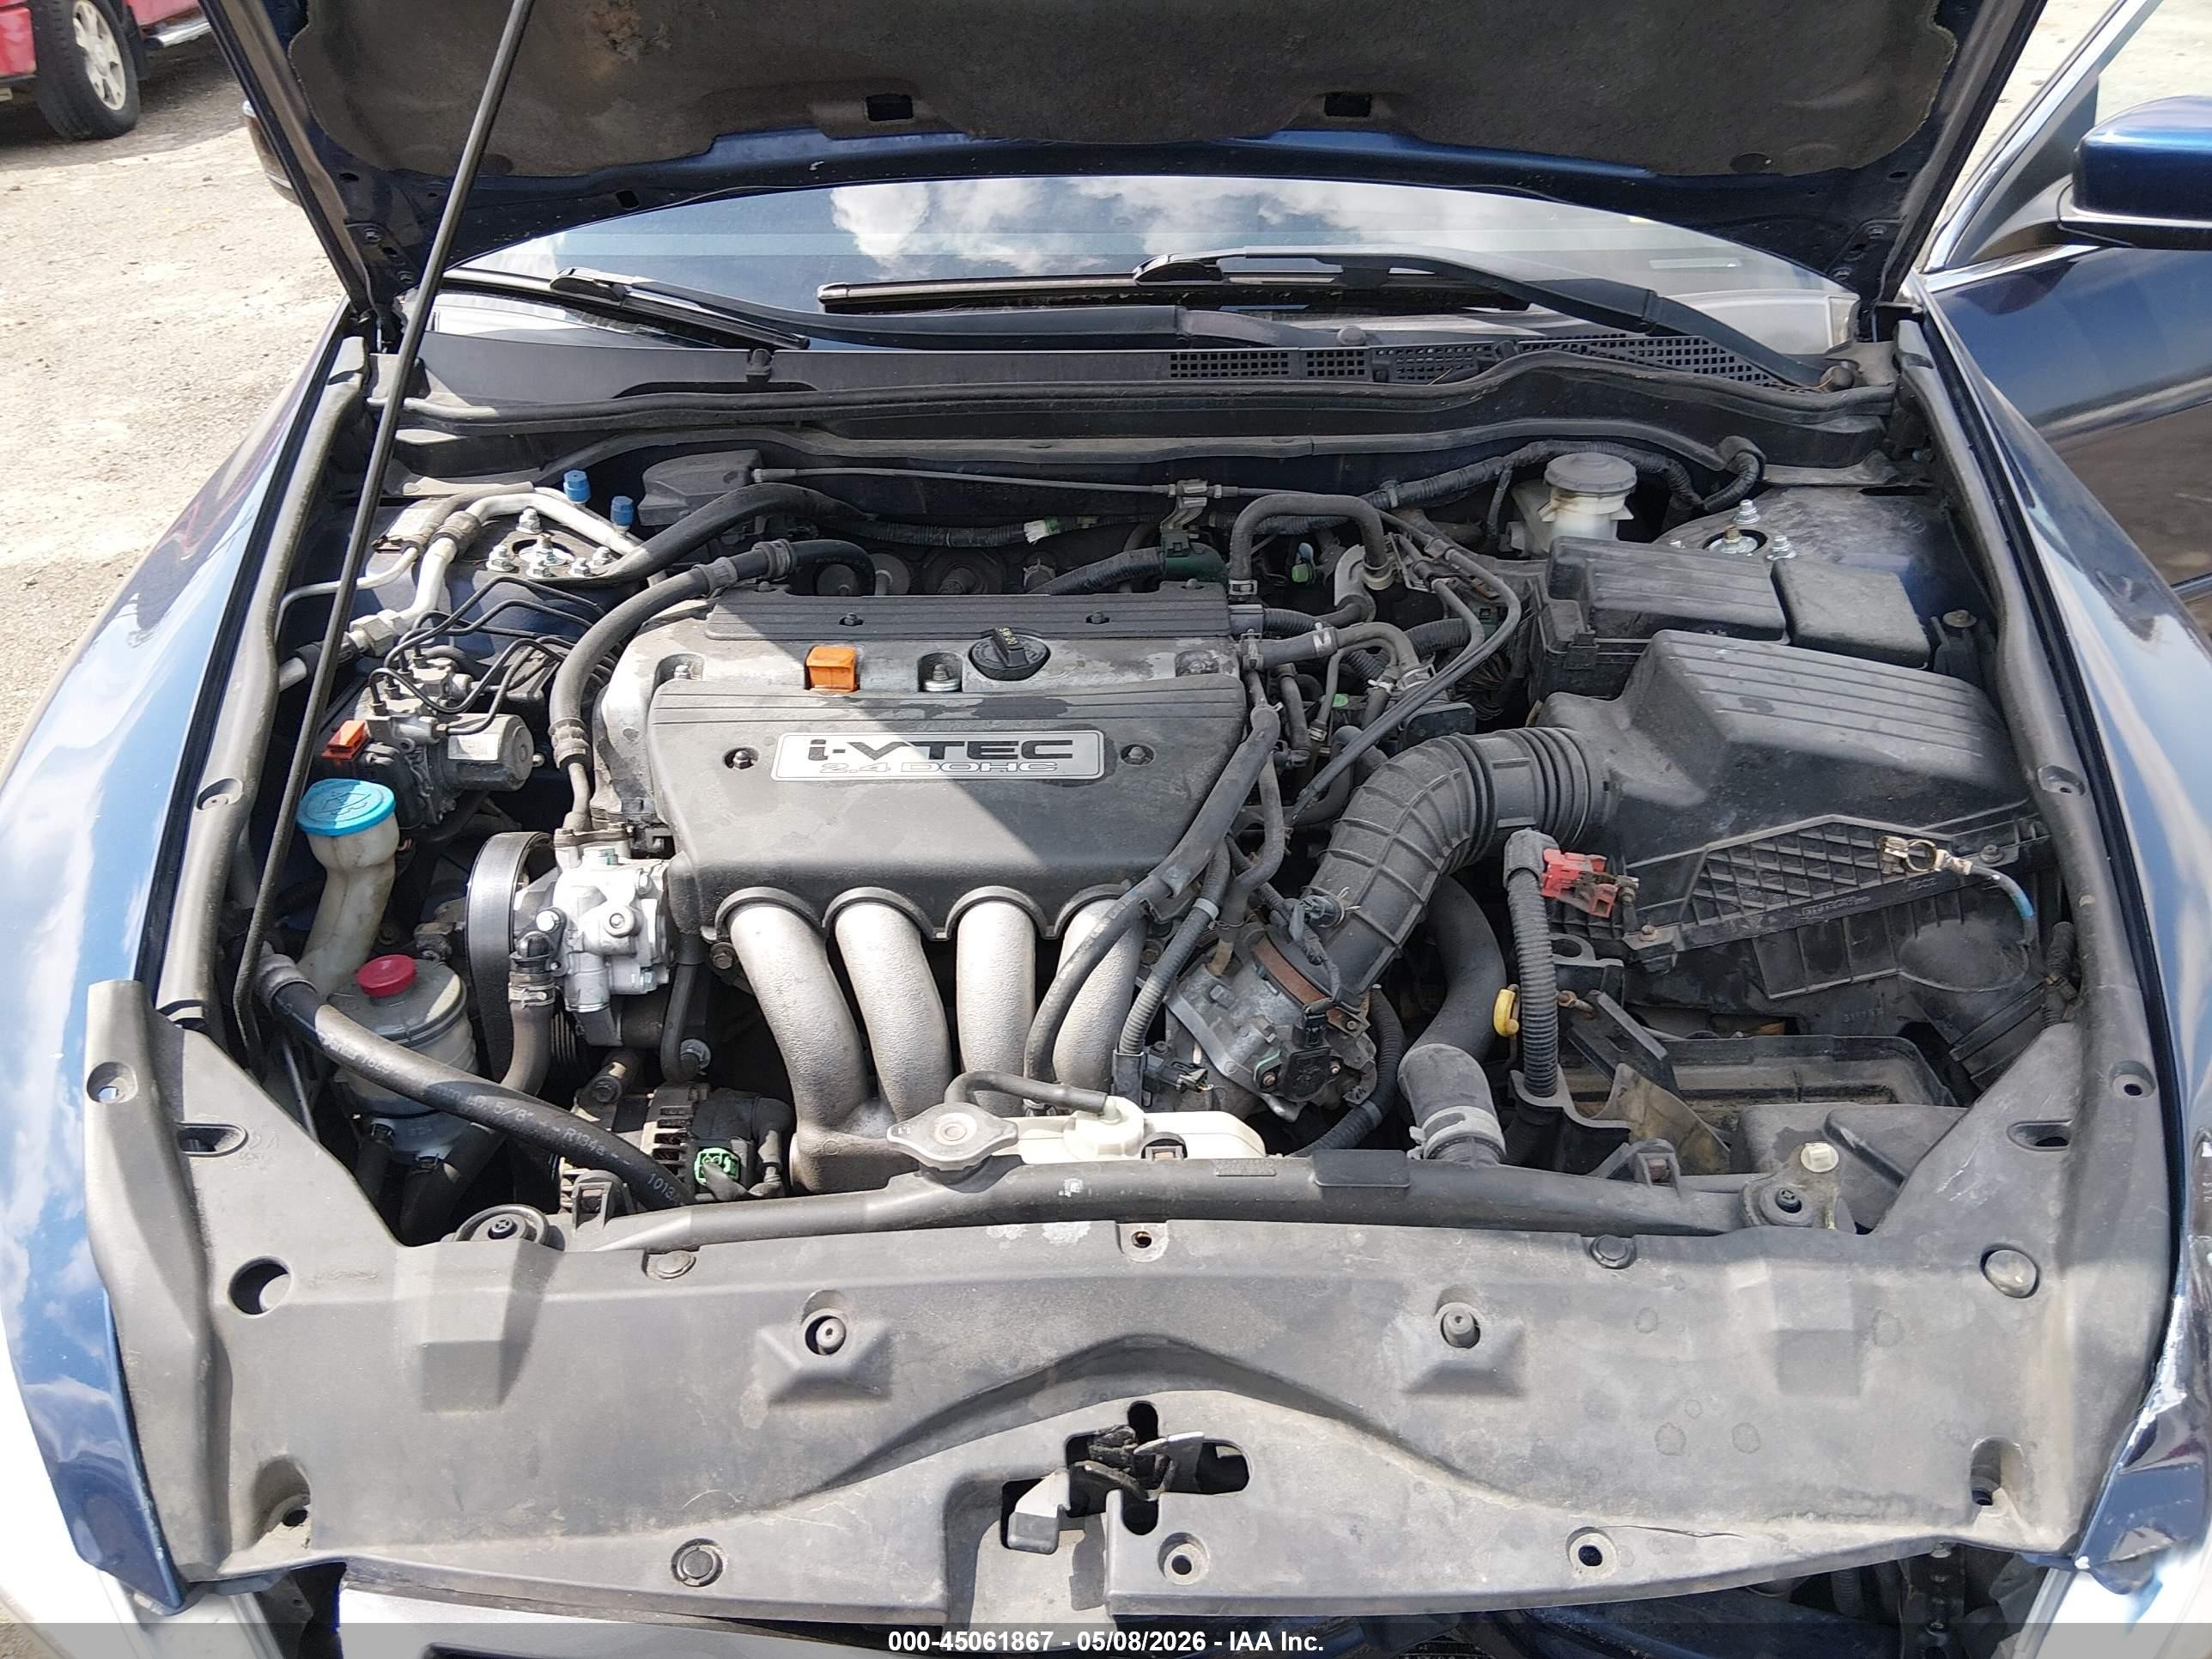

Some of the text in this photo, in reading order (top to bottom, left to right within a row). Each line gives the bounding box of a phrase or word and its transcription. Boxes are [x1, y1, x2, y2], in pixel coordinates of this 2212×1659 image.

[999, 628, 1018, 646] 5W-20
[808, 739, 1073, 762] i-VTEC
[820, 762, 1058, 773] 2.4 DOHC
